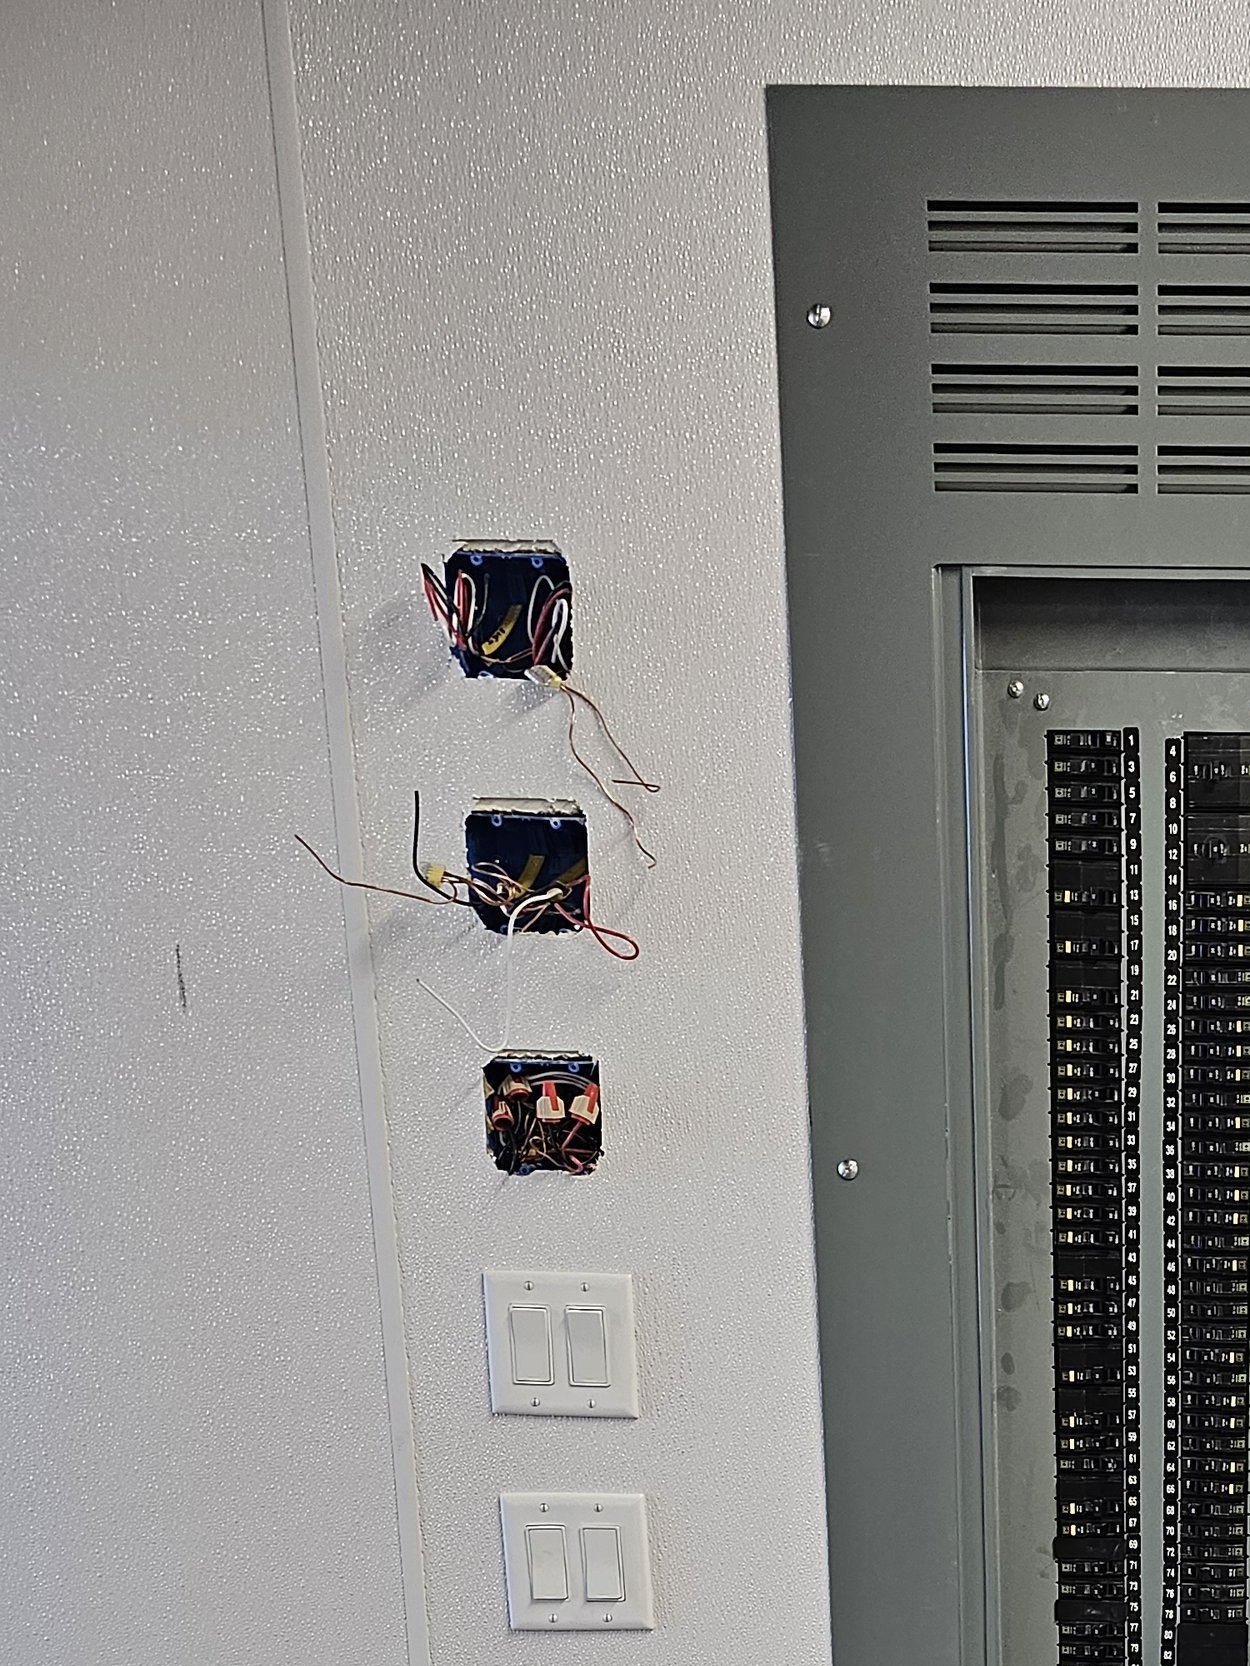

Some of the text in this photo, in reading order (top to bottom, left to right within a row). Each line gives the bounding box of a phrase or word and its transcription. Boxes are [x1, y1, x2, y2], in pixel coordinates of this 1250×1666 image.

[1128, 734, 1134, 746] 1
[1169, 745, 1177, 757] 4
[1128, 760, 1136, 773] 3
[1169, 771, 1177, 783] 6
[1128, 786, 1136, 799] 5
[1169, 796, 1177, 809] 8
[1129, 812, 1137, 824] 7
[1168, 823, 1178, 835] 10
[1129, 838, 1137, 850] 9
[1168, 848, 1178, 860] 12
[1129, 864, 1138, 875] 11
[1167, 874, 1178, 886] 14
[1129, 889, 1139, 901] 13
[1167, 899, 1178, 911] 16
[1129, 914, 1139, 926] 15
[1167, 924, 1178, 937] 18
[1130, 939, 1139, 951] 17
[1167, 949, 1178, 961] 20
[1130, 964, 1140, 976] 19
[1167, 974, 1177, 986] 22
[1130, 989, 1139, 1001] 21
[1167, 999, 1177, 1011] 24
[1128, 1062, 1138, 1074] 27
[1166, 1072, 1176, 1084] 30
[1127, 1086, 1137, 1098] 29
[1166, 1096, 1176, 1108] 32
[1127, 1110, 1136, 1122] 31
[1166, 1121, 1176, 1132] 34
[1165, 1144, 1175, 1156] 36
[1127, 1182, 1137, 1193] 37
[1166, 1191, 1176, 1203] 40
[1166, 1215, 1176, 1226] 42
[1127, 1229, 1137, 1240] 41
[1166, 1238, 1176, 1249] 44
[1127, 1252, 1137, 1263] 43
[1127, 1275, 1137, 1286] 45
[1127, 1297, 1137, 1308] 47
[1167, 1307, 1176, 1318] 50
[1127, 1320, 1137, 1331] 49
[1167, 1330, 1176, 1341] 52
[1127, 1343, 1137, 1354] 51
[1167, 1352, 1176, 1363] 54
[1127, 1409, 1137, 1420] 57
[1127, 1431, 1137, 1442] 59
[1167, 1441, 1176, 1451] 62
[1128, 1453, 1137, 1464] 61
[1166, 1462, 1176, 1473] 64
[1128, 1496, 1138, 1507] 65
[1128, 1517, 1138, 1528] 67
[1165, 1526, 1175, 1536] 70
[1129, 1560, 1138, 1570] 71
[1166, 1568, 1175, 1578] 74
[1165, 1588, 1175, 1599] 76
[1129, 1602, 1139, 1612] 75
[1129, 1622, 1139, 1632] 77
[1163, 1630, 1173, 1640] 80
[1130, 1643, 1139, 1653] 79
